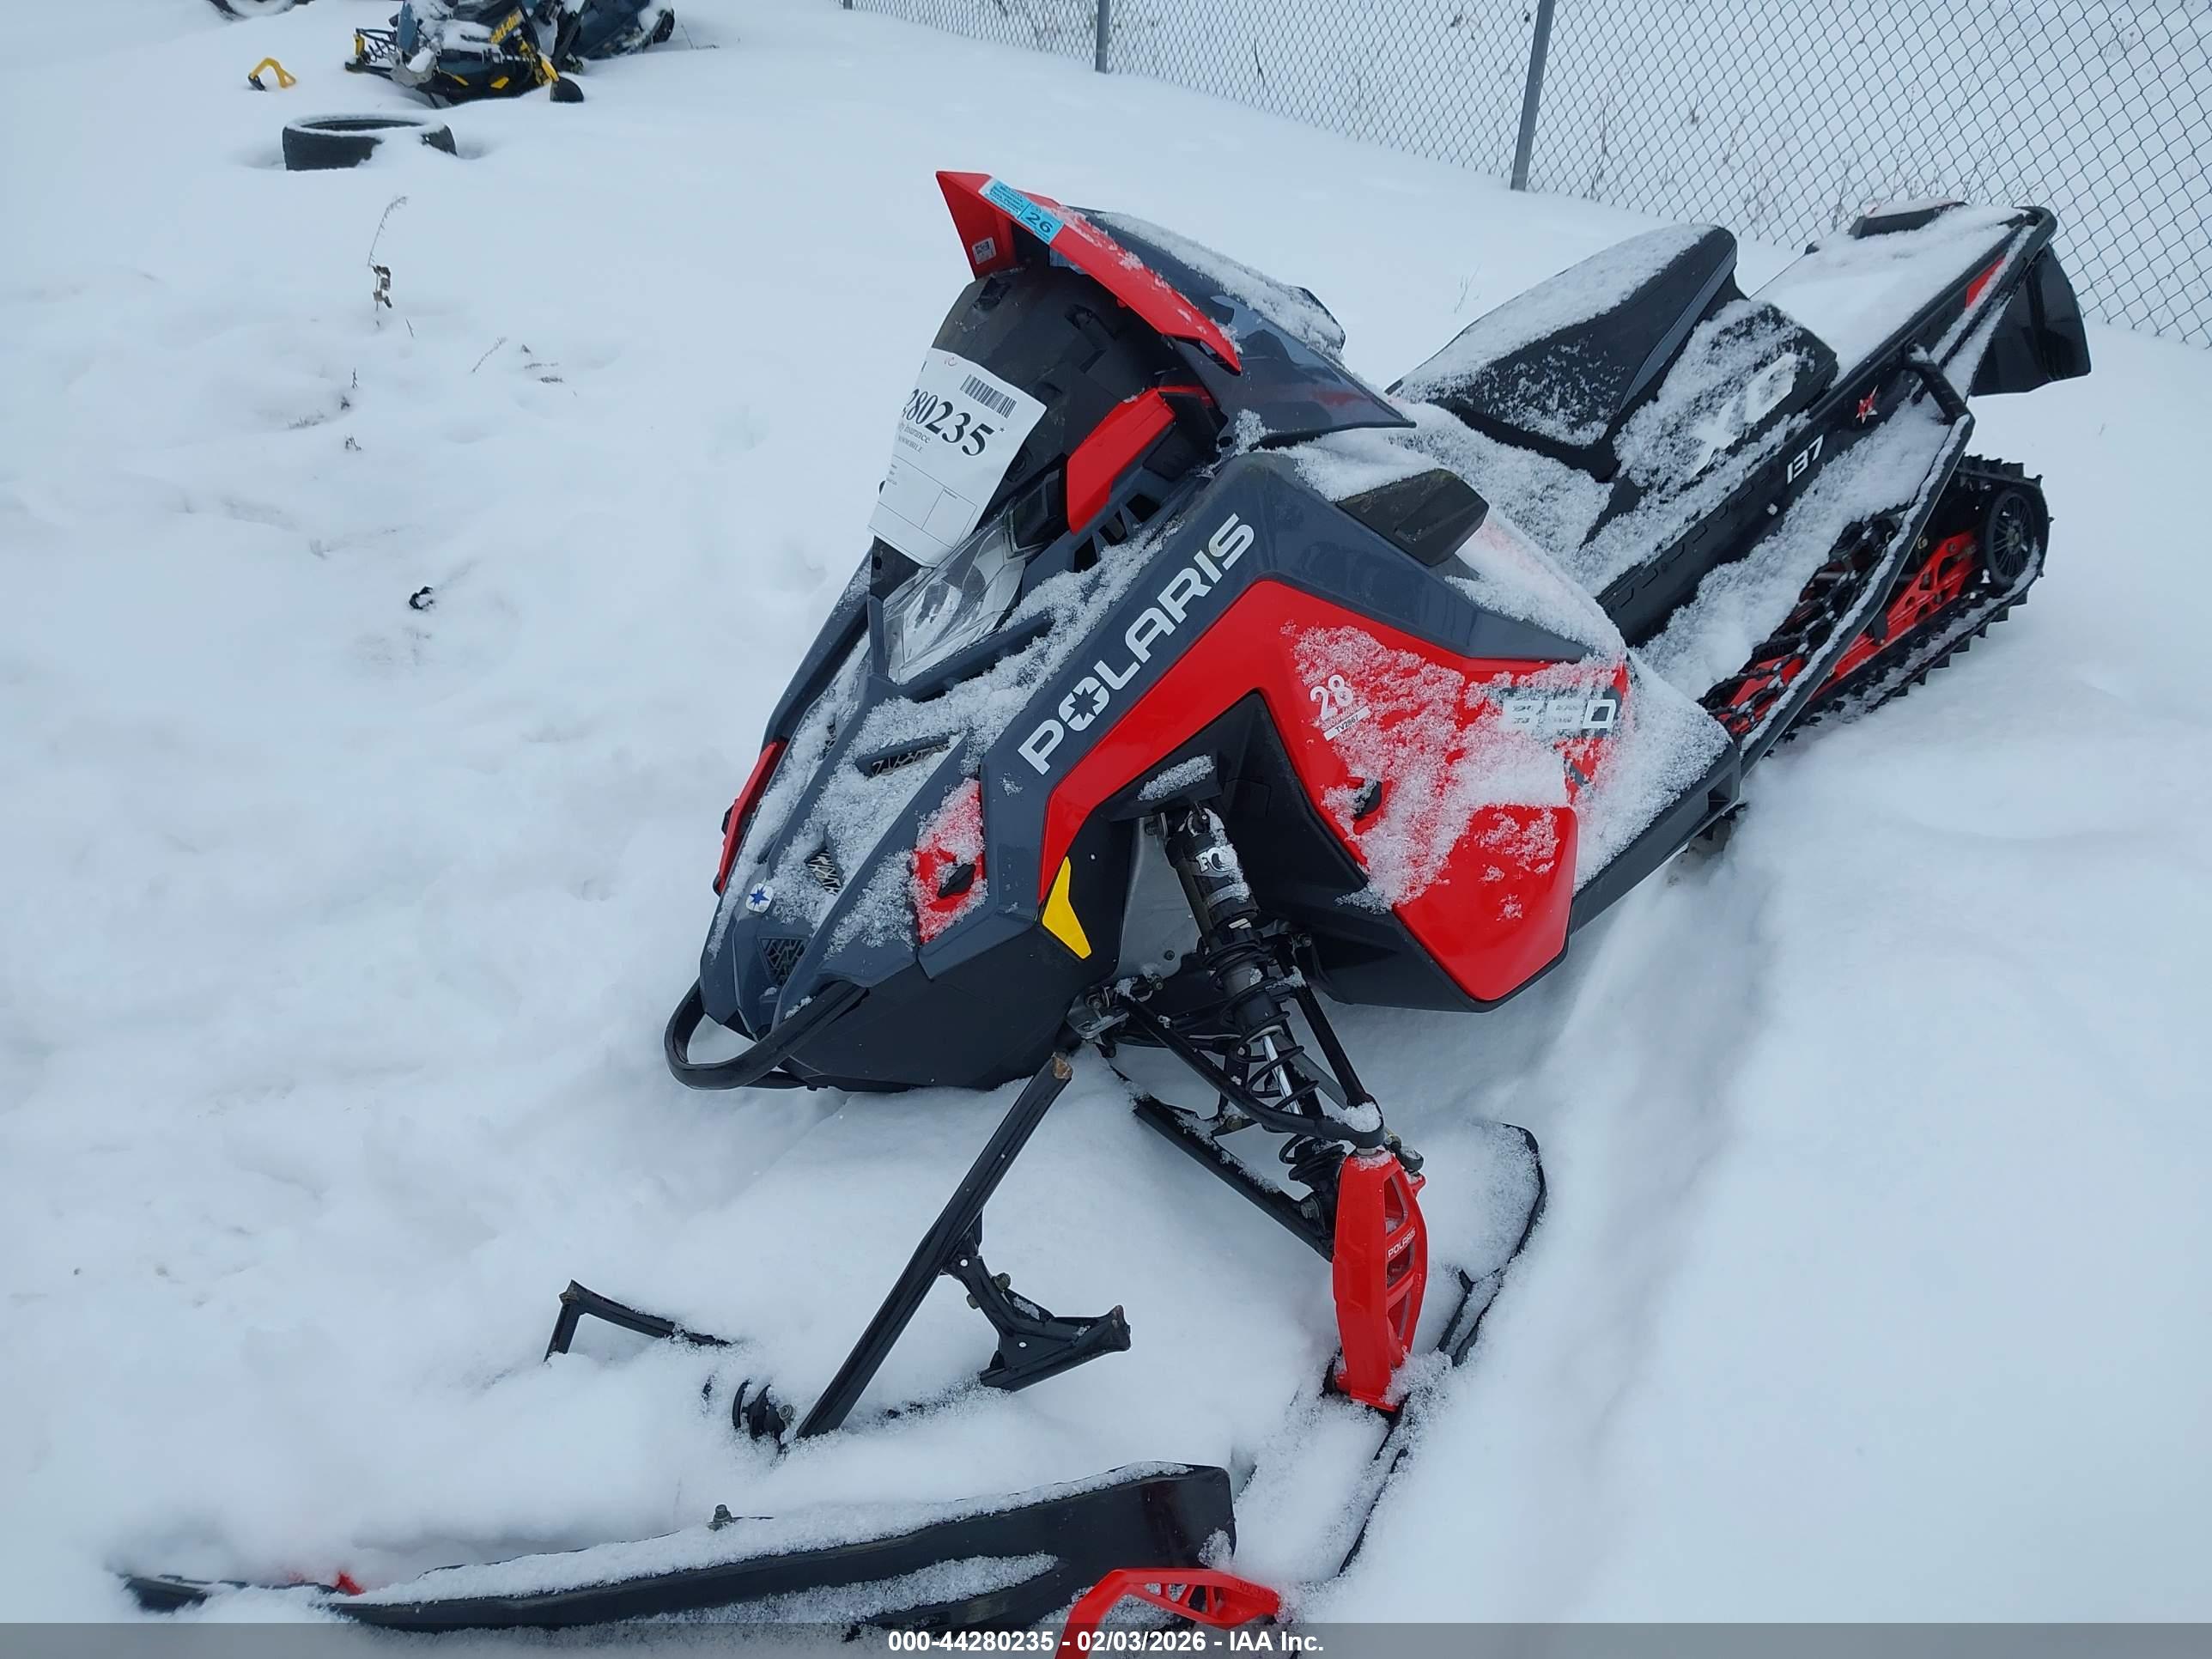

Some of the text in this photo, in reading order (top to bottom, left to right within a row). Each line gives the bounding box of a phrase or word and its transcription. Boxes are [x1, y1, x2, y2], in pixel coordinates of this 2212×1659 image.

[1025, 211, 1053, 234] 26
[1786, 433, 1824, 485] 137
[1017, 512, 1255, 776] POLARIS
[1310, 674, 1354, 721] 28
[1194, 846, 1237, 874] FO
[1387, 1226, 1417, 1259] POLARIS
